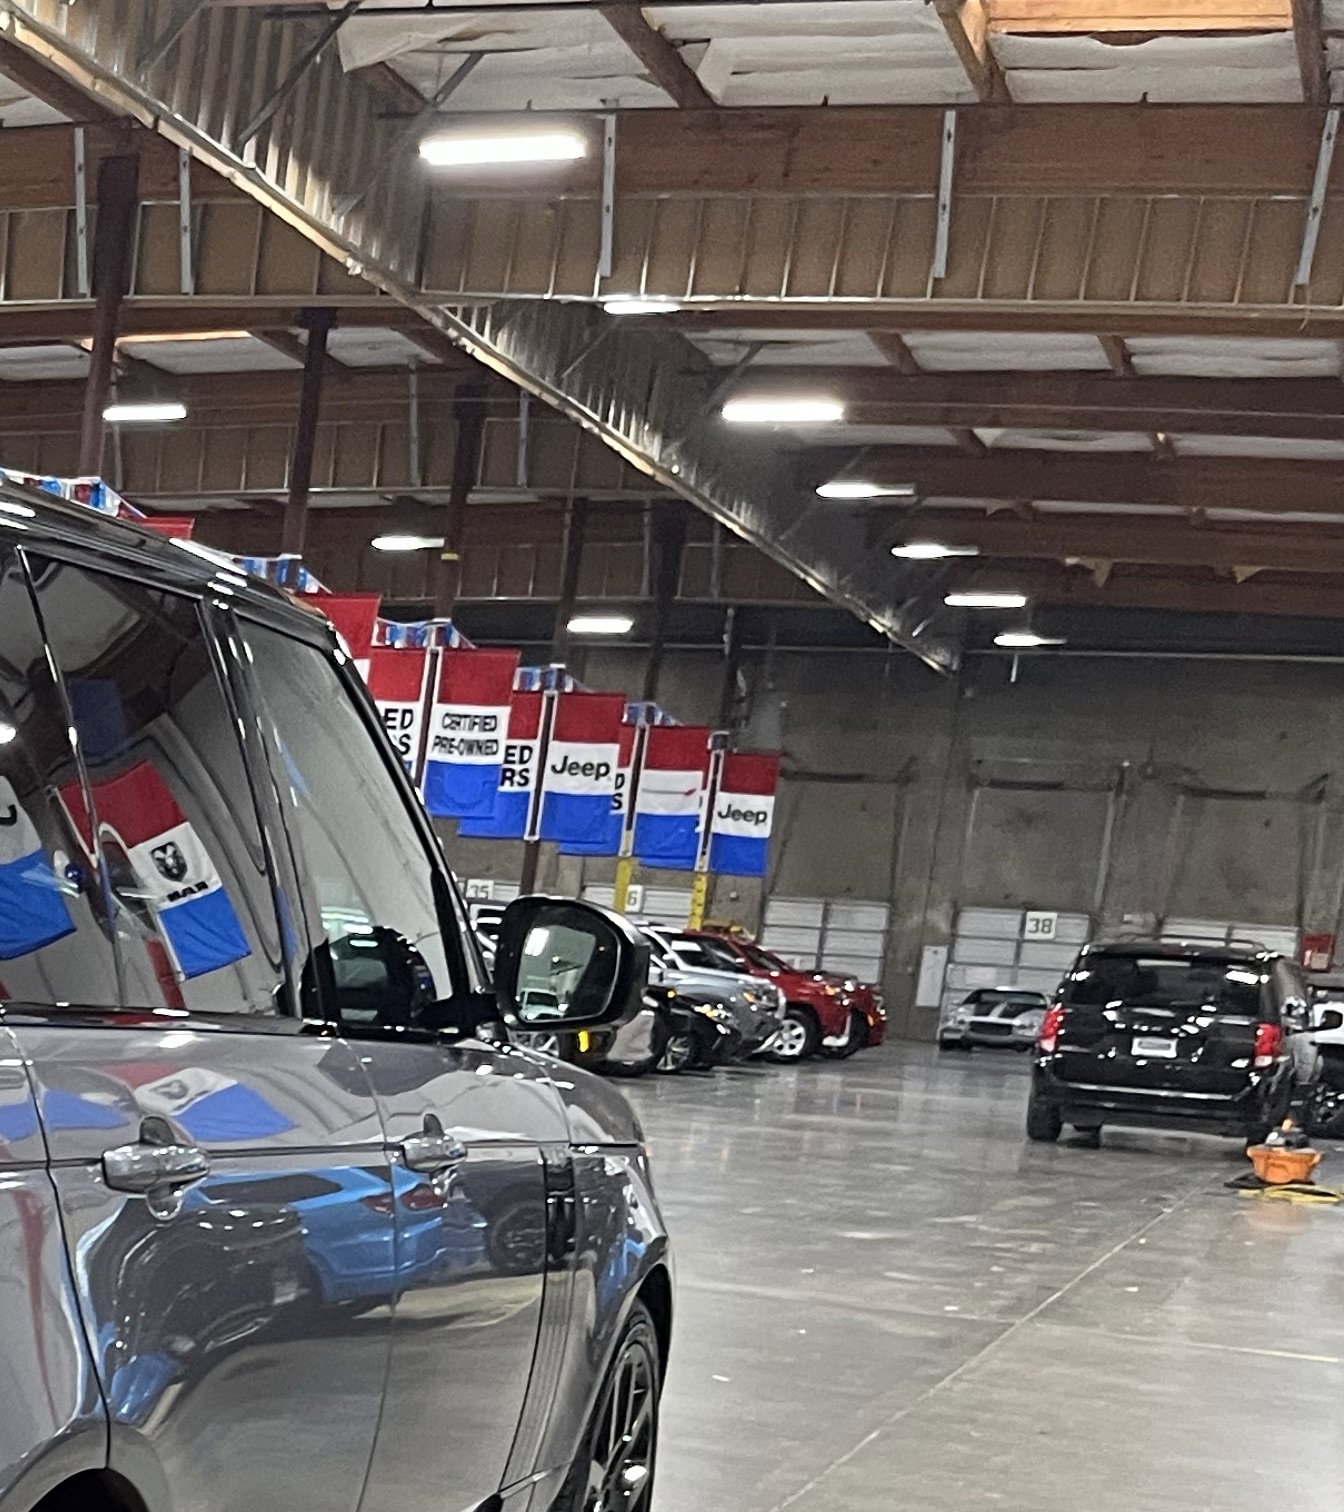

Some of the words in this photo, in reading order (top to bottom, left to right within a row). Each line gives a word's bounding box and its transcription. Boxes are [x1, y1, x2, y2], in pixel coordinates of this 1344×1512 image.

[384, 708, 414, 730] ED
[442, 713, 497, 732] CERTIFIED
[432, 735, 499, 756] PRE-OWNED
[503, 745, 534, 765] ED
[500, 768, 530, 788] RS
[551, 755, 611, 781] Jeep
[718, 804, 768, 826] Jeep
[627, 890, 638, 906] 6
[1027, 917, 1053, 934] 38
